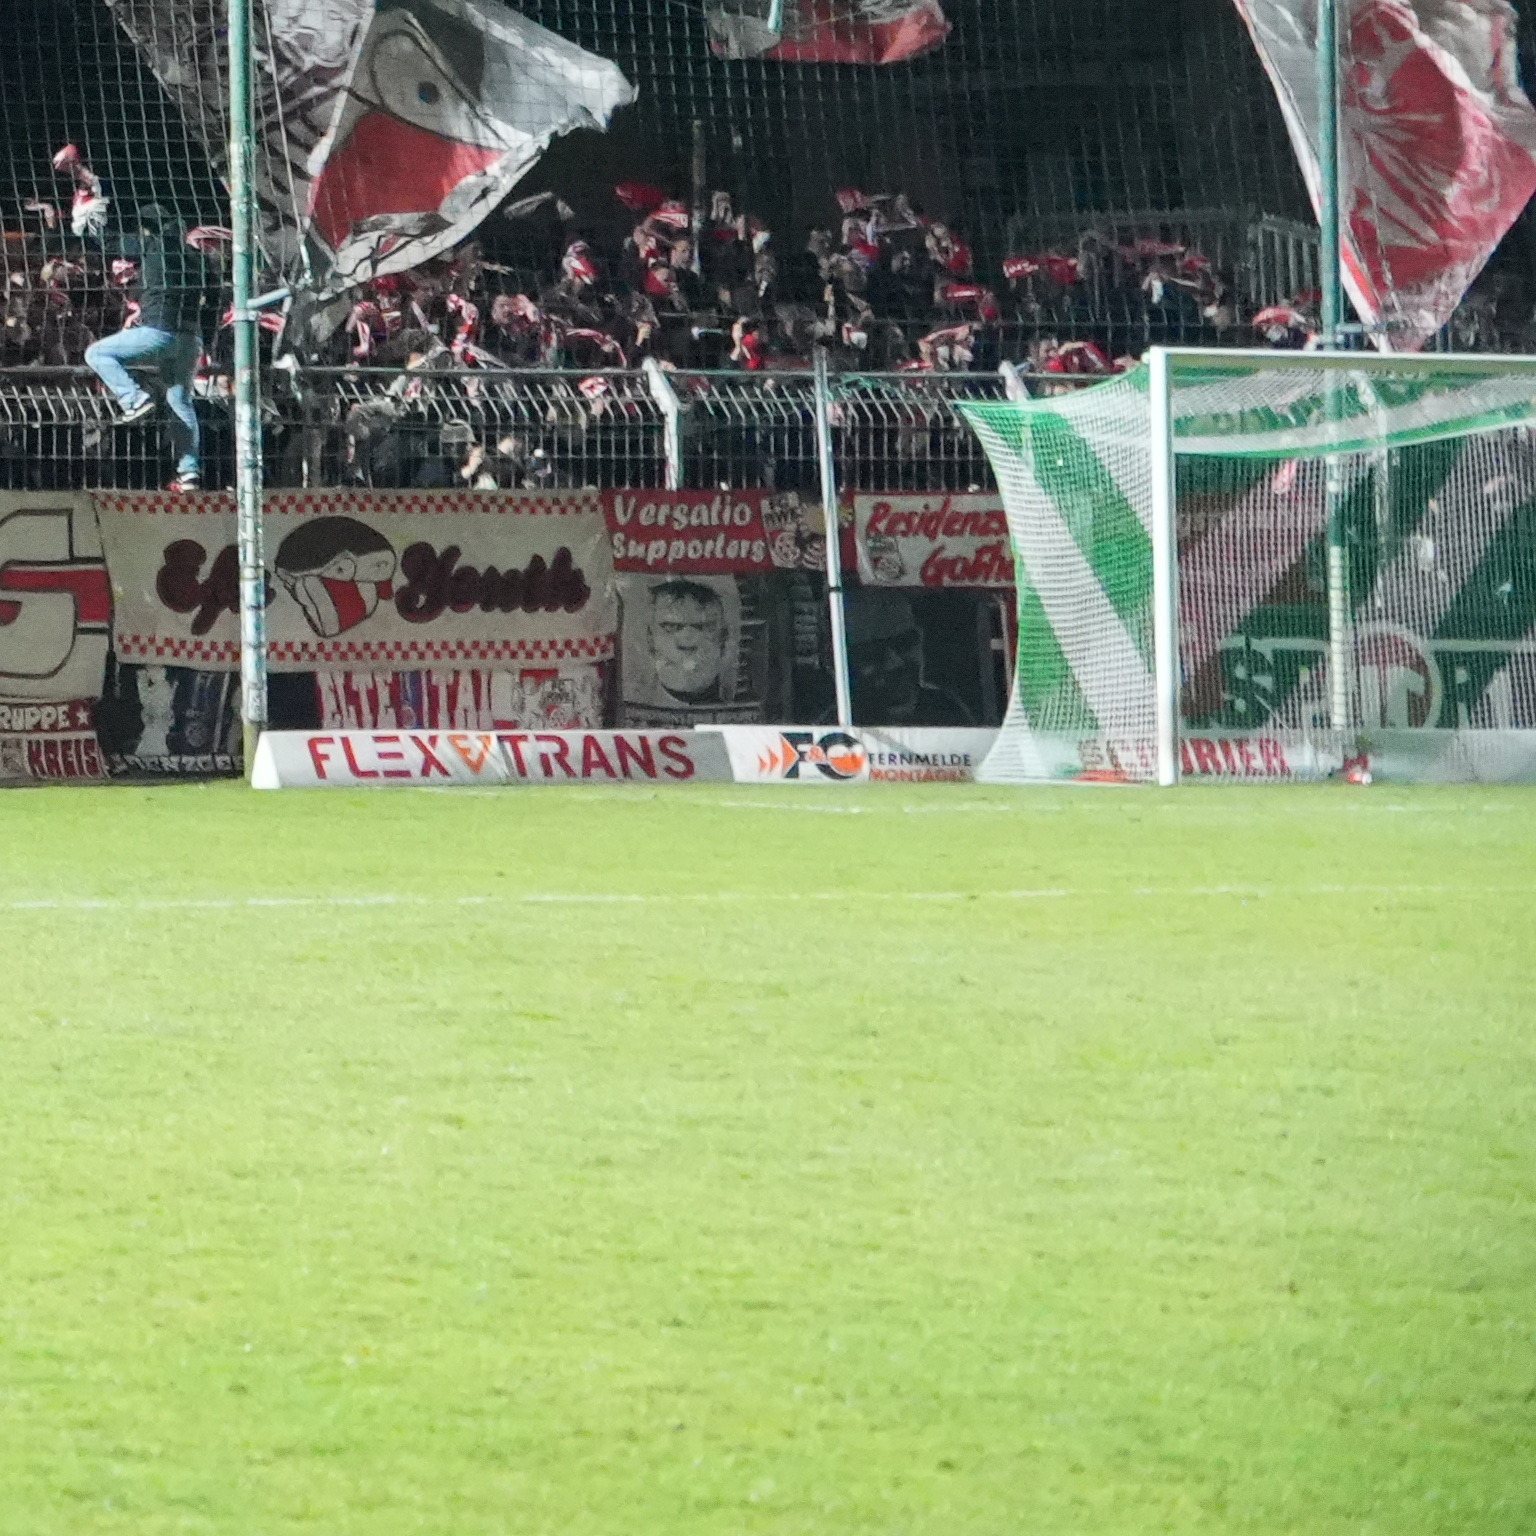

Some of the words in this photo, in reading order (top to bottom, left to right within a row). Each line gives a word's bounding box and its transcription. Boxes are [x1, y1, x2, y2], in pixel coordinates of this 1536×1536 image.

[306, 735, 451, 779] FLEX
[496, 734, 696, 780] TRANS
[868, 753, 972, 767] FERNMELDE
